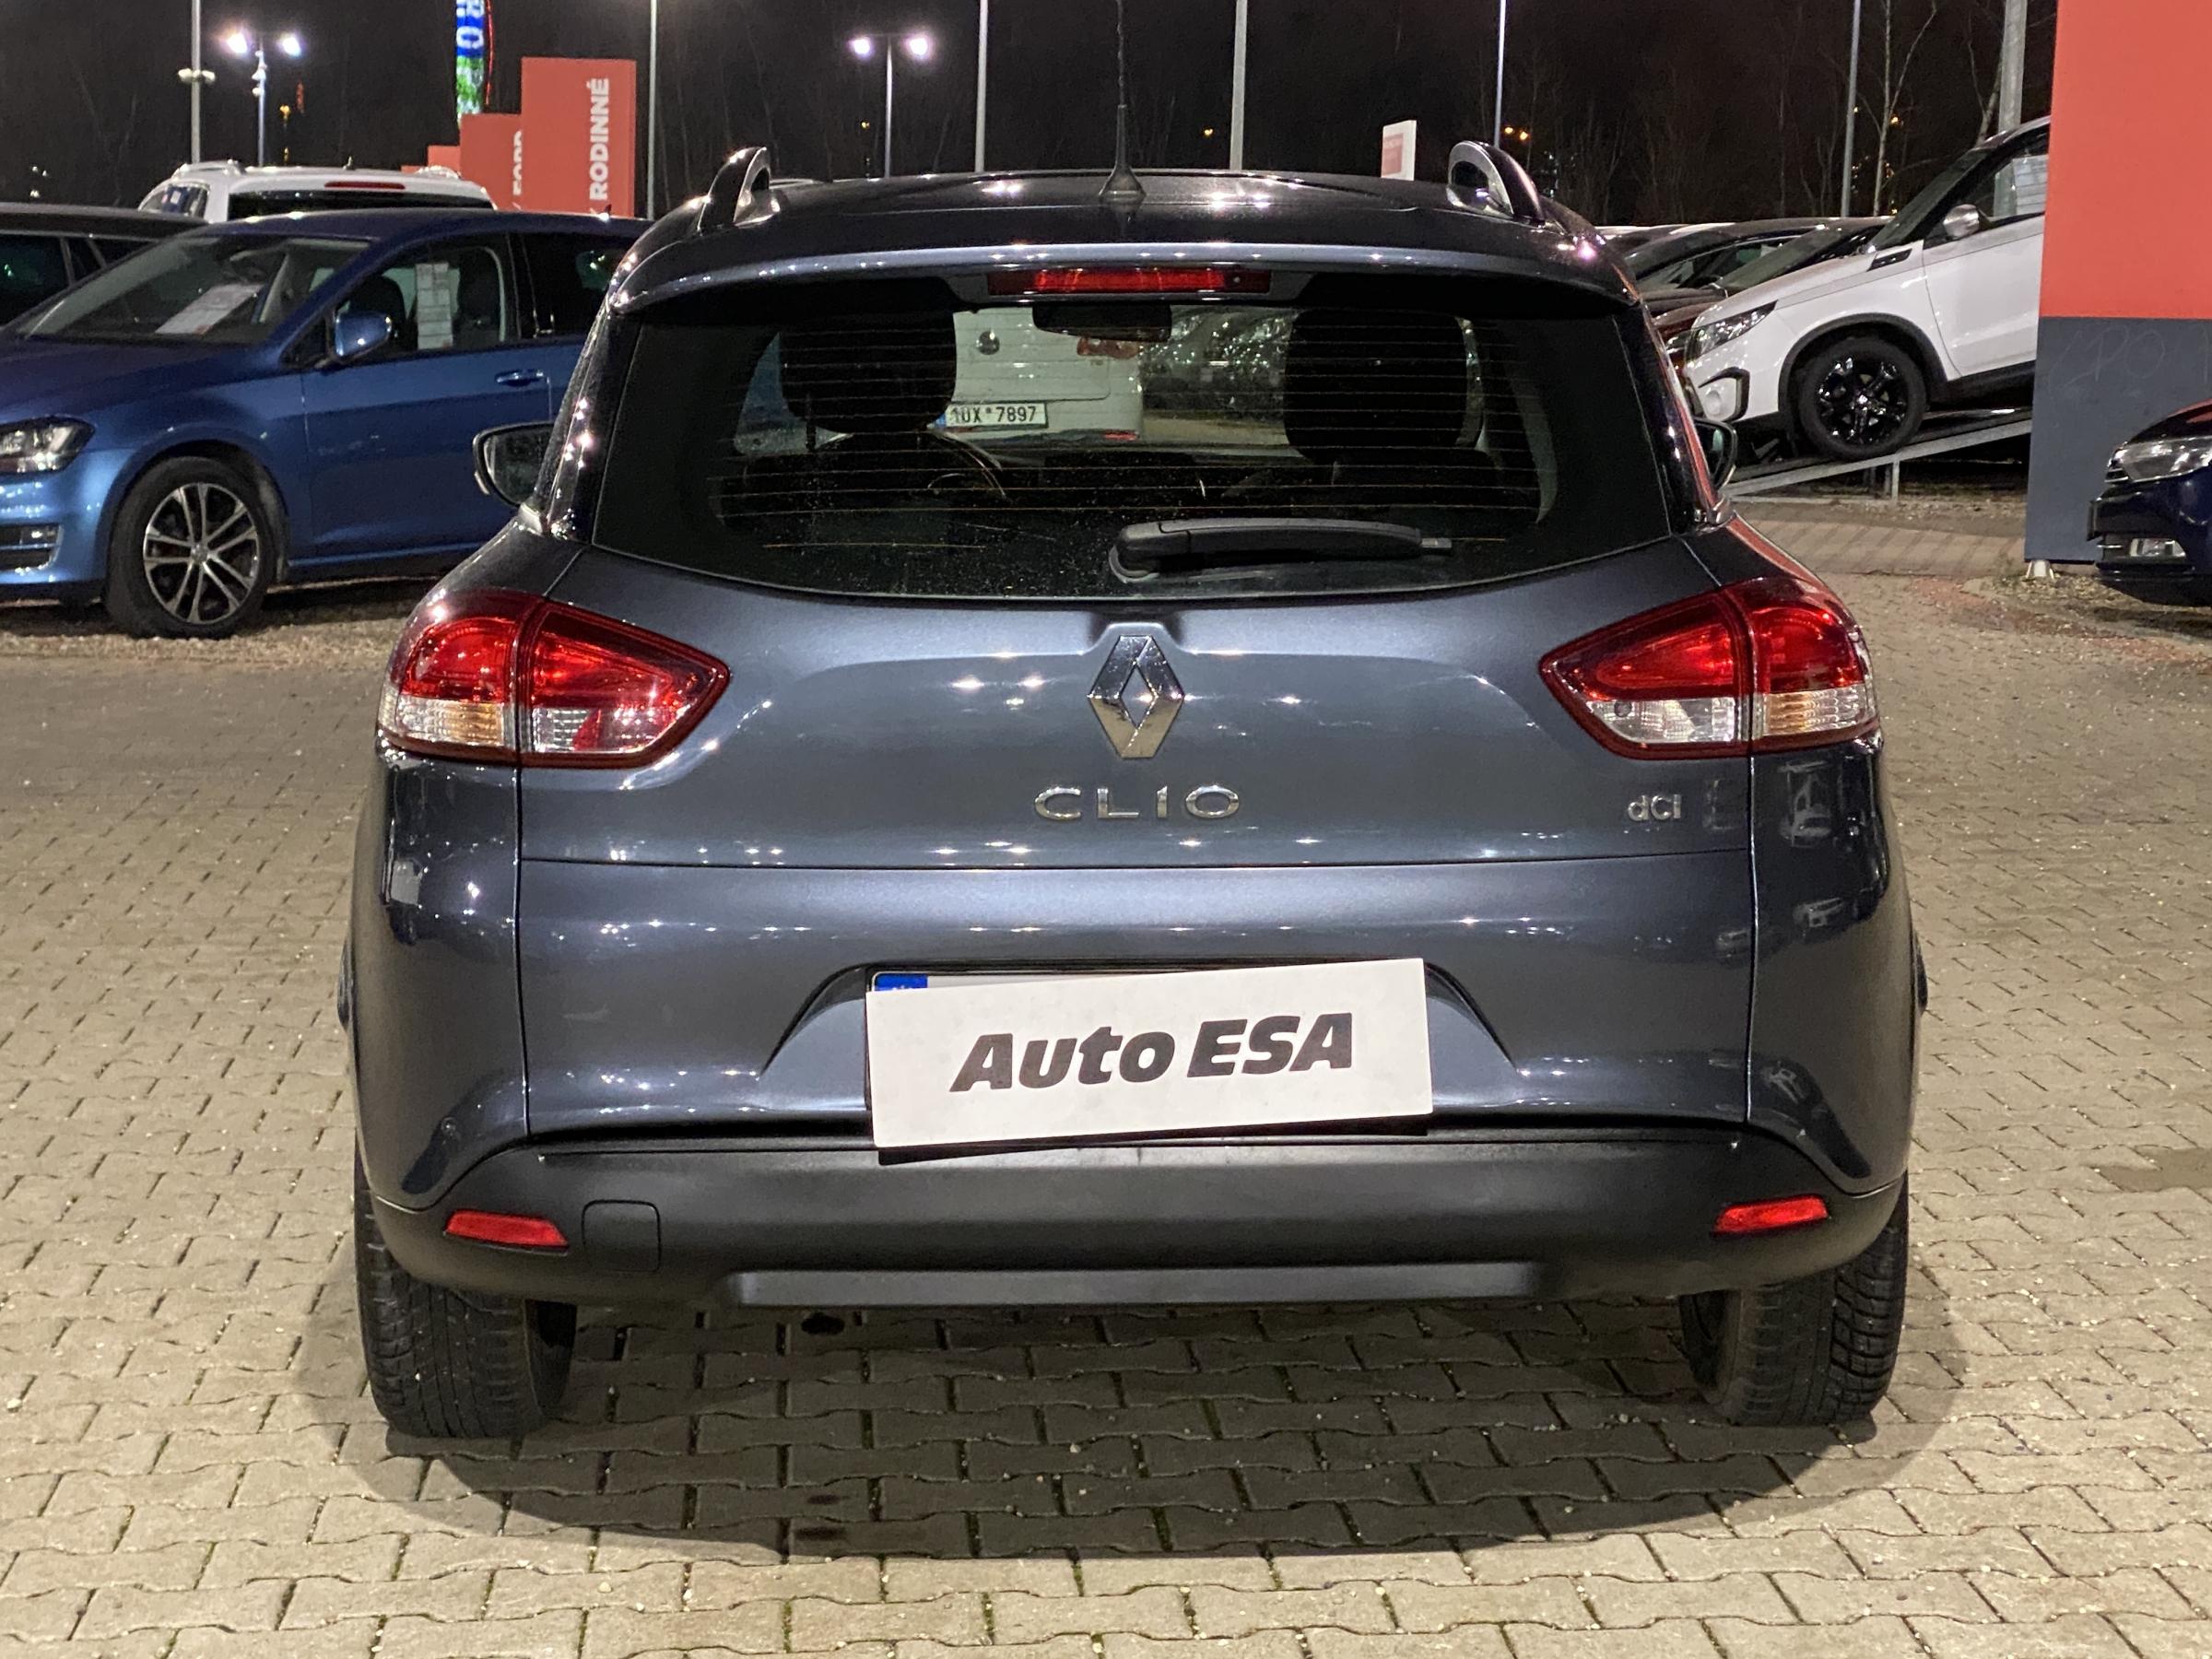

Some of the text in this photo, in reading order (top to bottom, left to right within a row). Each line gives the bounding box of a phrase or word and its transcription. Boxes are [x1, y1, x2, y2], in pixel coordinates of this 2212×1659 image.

[586, 78, 609, 200] RODINNÉ
[995, 406, 1037, 422] 7897
[1034, 784, 1240, 819] CLIO
[949, 1012, 1353, 1092] Auto ESA
